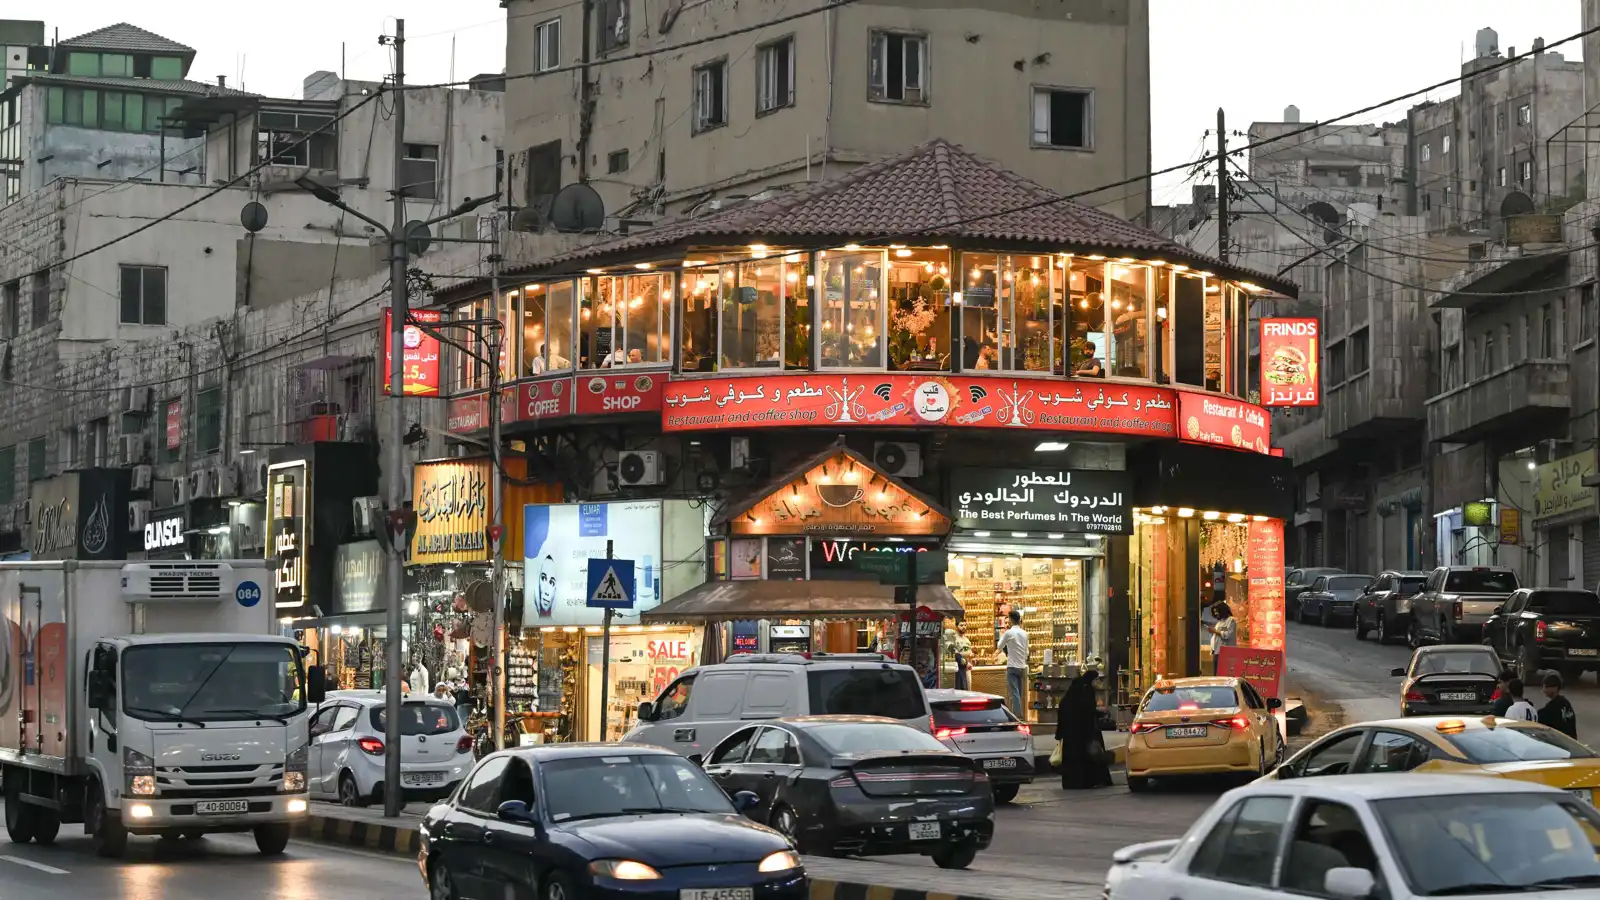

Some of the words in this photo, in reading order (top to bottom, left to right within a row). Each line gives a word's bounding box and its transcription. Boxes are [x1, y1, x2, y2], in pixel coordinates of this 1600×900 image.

[1263, 322, 1317, 336] FRINDS
[665, 386, 711, 407] شوب
[715, 383, 764, 407] كوفي
[771, 389, 781, 402] و
[786, 382, 823, 404] مطعم
[1038, 388, 1083, 404] شوب
[1087, 388, 1129, 411] كوفي
[1266, 387, 1315, 404] فرندز
[528, 399, 560, 416] COFFEE
[603, 395, 641, 410] SHOP
[920, 405, 944, 414] عمان
[1133, 399, 1141, 411] و
[1145, 394, 1171, 415] مطعم
[1203, 400, 1237, 418] Restaurant
[667, 412, 726, 426] Restaurant
[727, 411, 749, 422] and
[752, 409, 787, 421] coffee
[789, 409, 817, 422] shop
[1039, 413, 1098, 426] Restaurant
[1100, 418, 1120, 428] and
[1121, 421, 1150, 429] coffee
[1150, 421, 1173, 433] shop
[1012, 472, 1071, 487] للعطور
[1551, 460, 1580, 491] مزاج
[958, 488, 1034, 508] الجالودي
[1054, 490, 1122, 508] الدردوك
[959, 510, 978, 519] The
[981, 510, 1004, 519] Best
[1007, 511, 1055, 521] Perfumes
[1058, 513, 1068, 521] In
[1071, 513, 1089, 522] The
[1092, 514, 1122, 524] World
[1086, 523, 1122, 531] 0797702810
[453, 531, 484, 551] BAZAAR
[237, 589, 259, 600] 084
[648, 641, 687, 659] SALE
[201, 753, 240, 761] ISUZU
[205, 802, 246, 812] 40-80084
